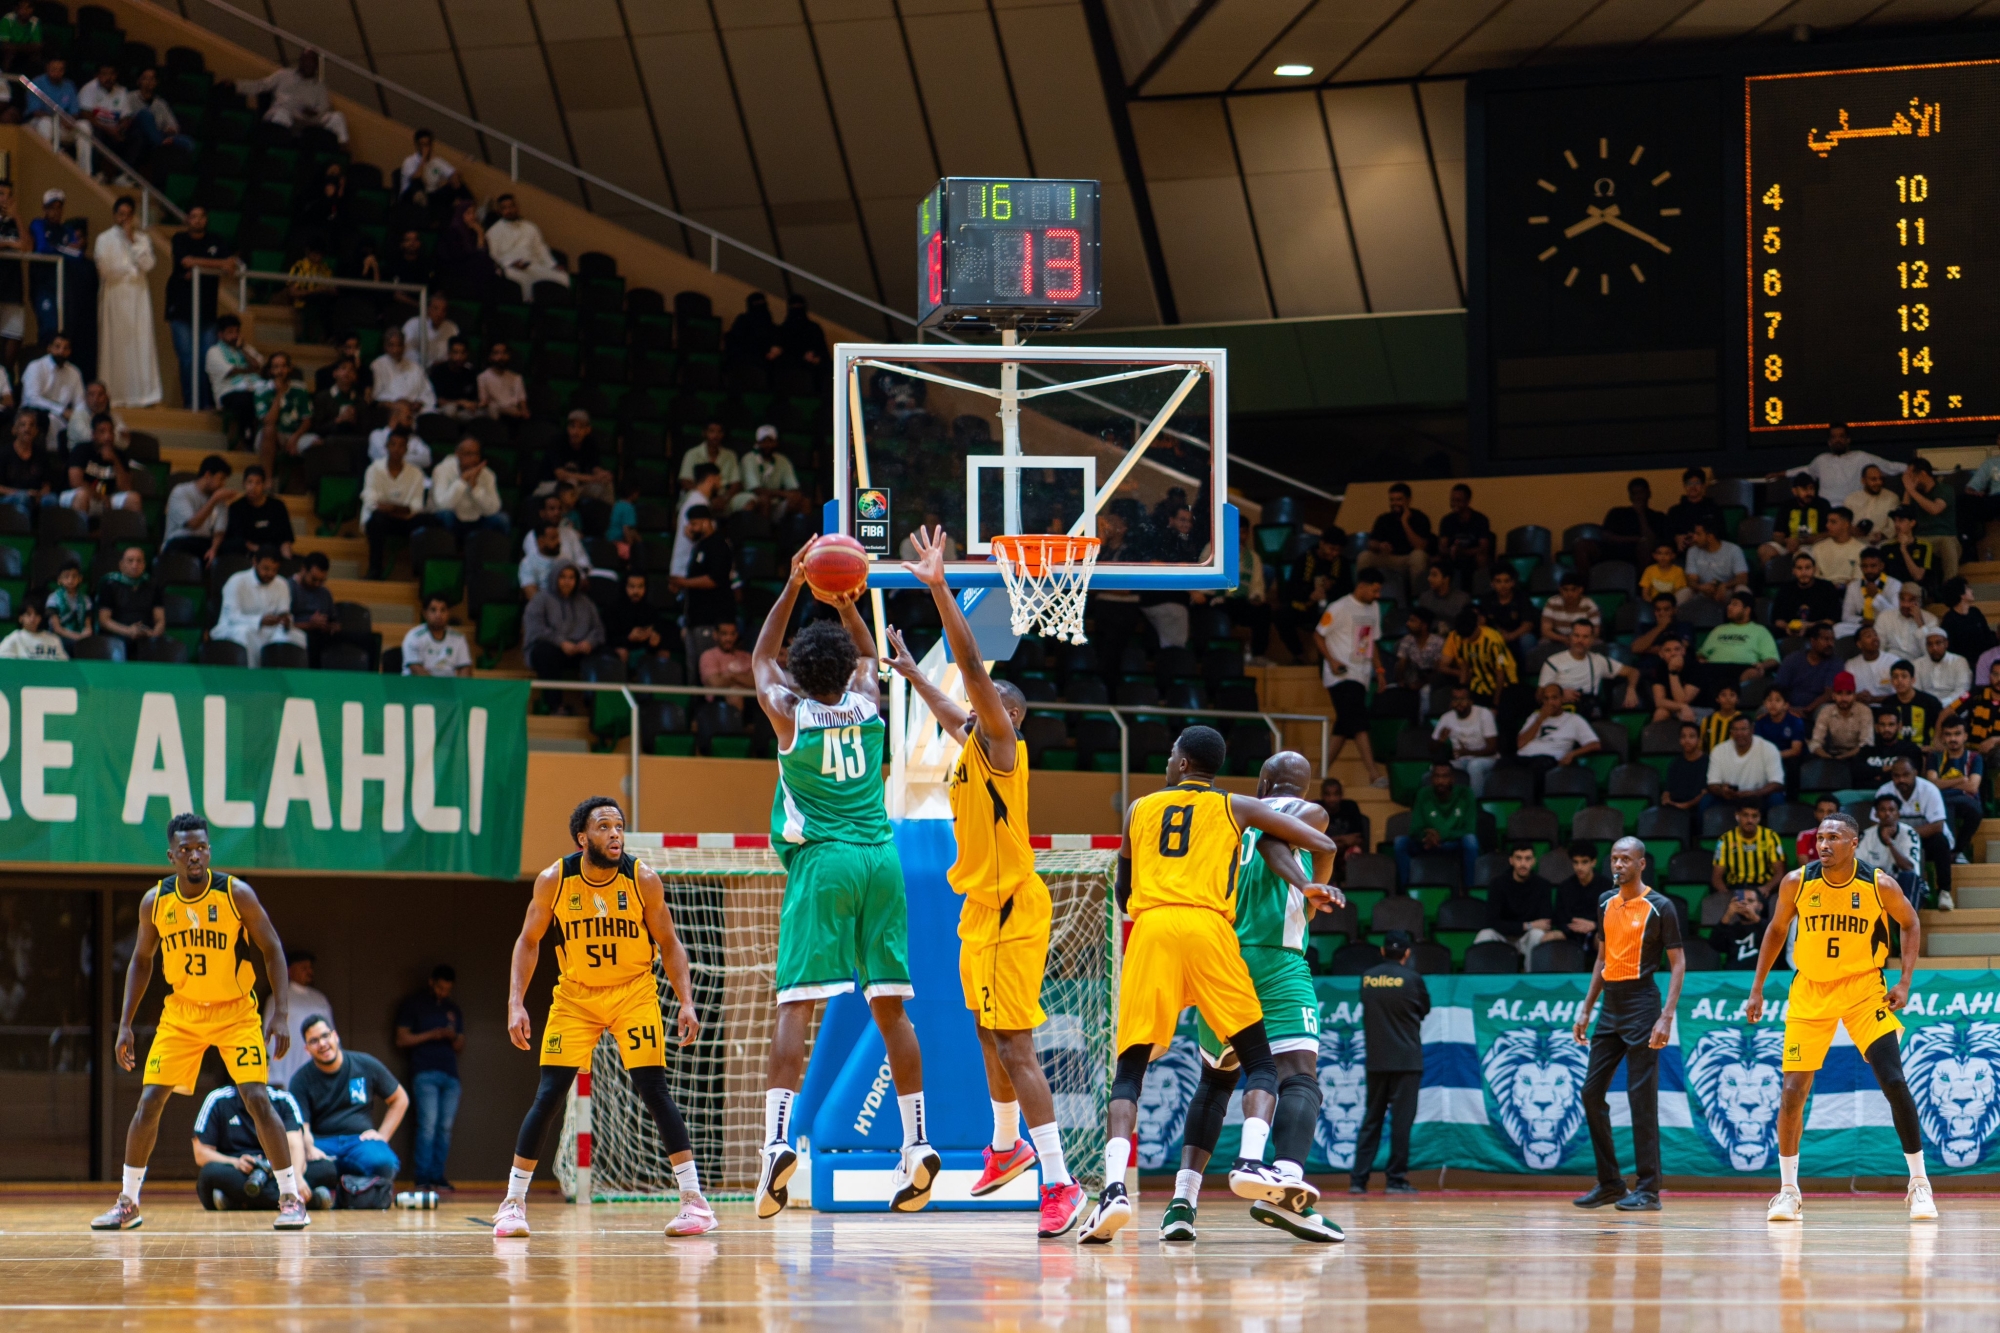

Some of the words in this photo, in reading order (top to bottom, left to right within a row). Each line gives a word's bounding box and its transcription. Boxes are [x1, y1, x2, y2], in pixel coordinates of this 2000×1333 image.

[981, 184, 1012, 220] 16
[1762, 183, 1784, 211] 4
[1895, 174, 1928, 204] 10
[1763, 226, 1781, 255] 5
[1896, 217, 1926, 247] 11
[1023, 228, 1082, 300] 13
[1897, 260, 1929, 290] 12
[1763, 268, 1782, 297] 6
[1764, 311, 1782, 340] 7
[1897, 303, 1930, 333] 13
[1764, 354, 1783, 382] 8
[1898, 346, 1934, 376] 14
[1765, 396, 1784, 425] 9
[1898, 389, 1931, 418] 15
[861, 525, 884, 537] FIBA
[121, 691, 489, 836] ALAHLI
[821, 725, 867, 783] 43
[1159, 805, 1194, 858] 8
[565, 917, 640, 941] ITTIHAD
[1805, 914, 1869, 934] ITTIHAD
[165, 928, 228, 953] ITTIHAD
[1827, 937, 1840, 958] 6
[184, 953, 207, 976] 23
[586, 943, 617, 968] 54
[1363, 975, 1404, 988] Police
[1301, 1006, 1318, 1034] 15
[627, 1025, 657, 1051] 54
[235, 1045, 262, 1067] 23
[853, 1052, 894, 1137] HYDRO
